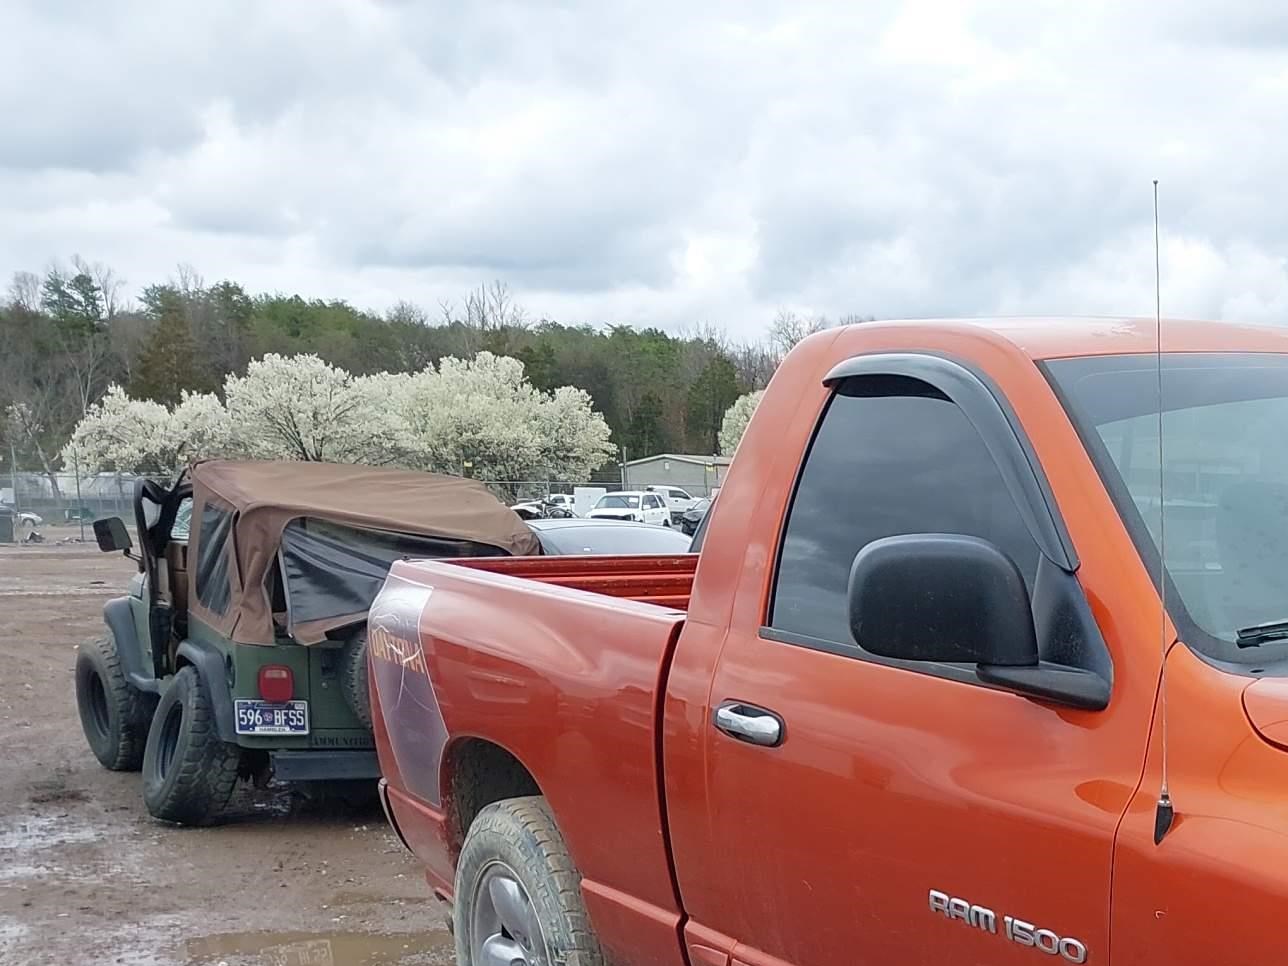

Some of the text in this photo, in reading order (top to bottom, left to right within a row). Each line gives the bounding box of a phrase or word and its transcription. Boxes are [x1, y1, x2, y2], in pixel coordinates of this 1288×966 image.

[239, 709, 305, 726] 596 BFSS
[928, 889, 1089, 965] RAM 1500
